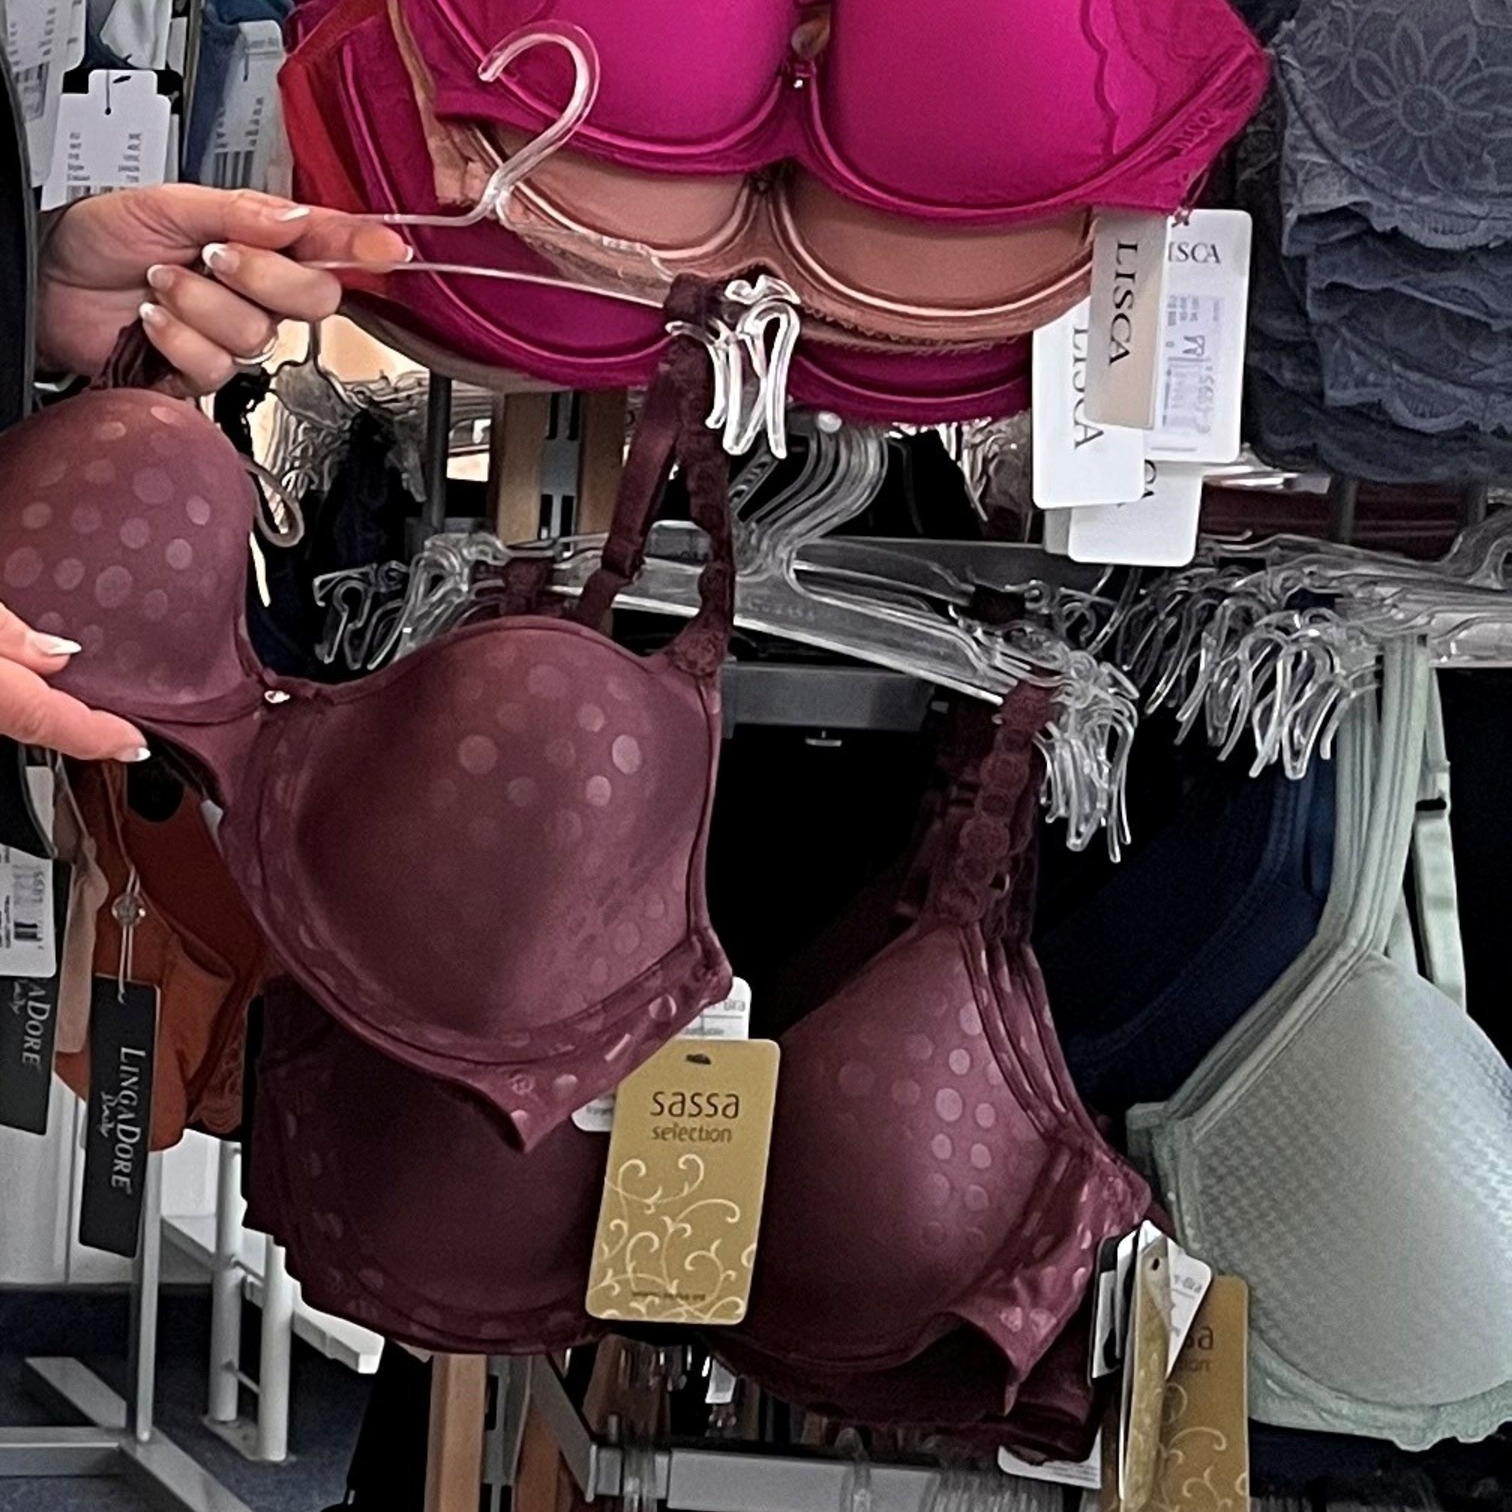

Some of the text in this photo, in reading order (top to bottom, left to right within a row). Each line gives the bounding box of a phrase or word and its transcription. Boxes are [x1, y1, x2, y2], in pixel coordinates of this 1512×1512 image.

[1167, 241, 1221, 264] ISCA
[1108, 241, 1138, 366] LISCA
[110, 1046, 147, 1190] LINGADORE
[649, 1090, 740, 1120] sassa
[651, 1124, 733, 1144] selection
